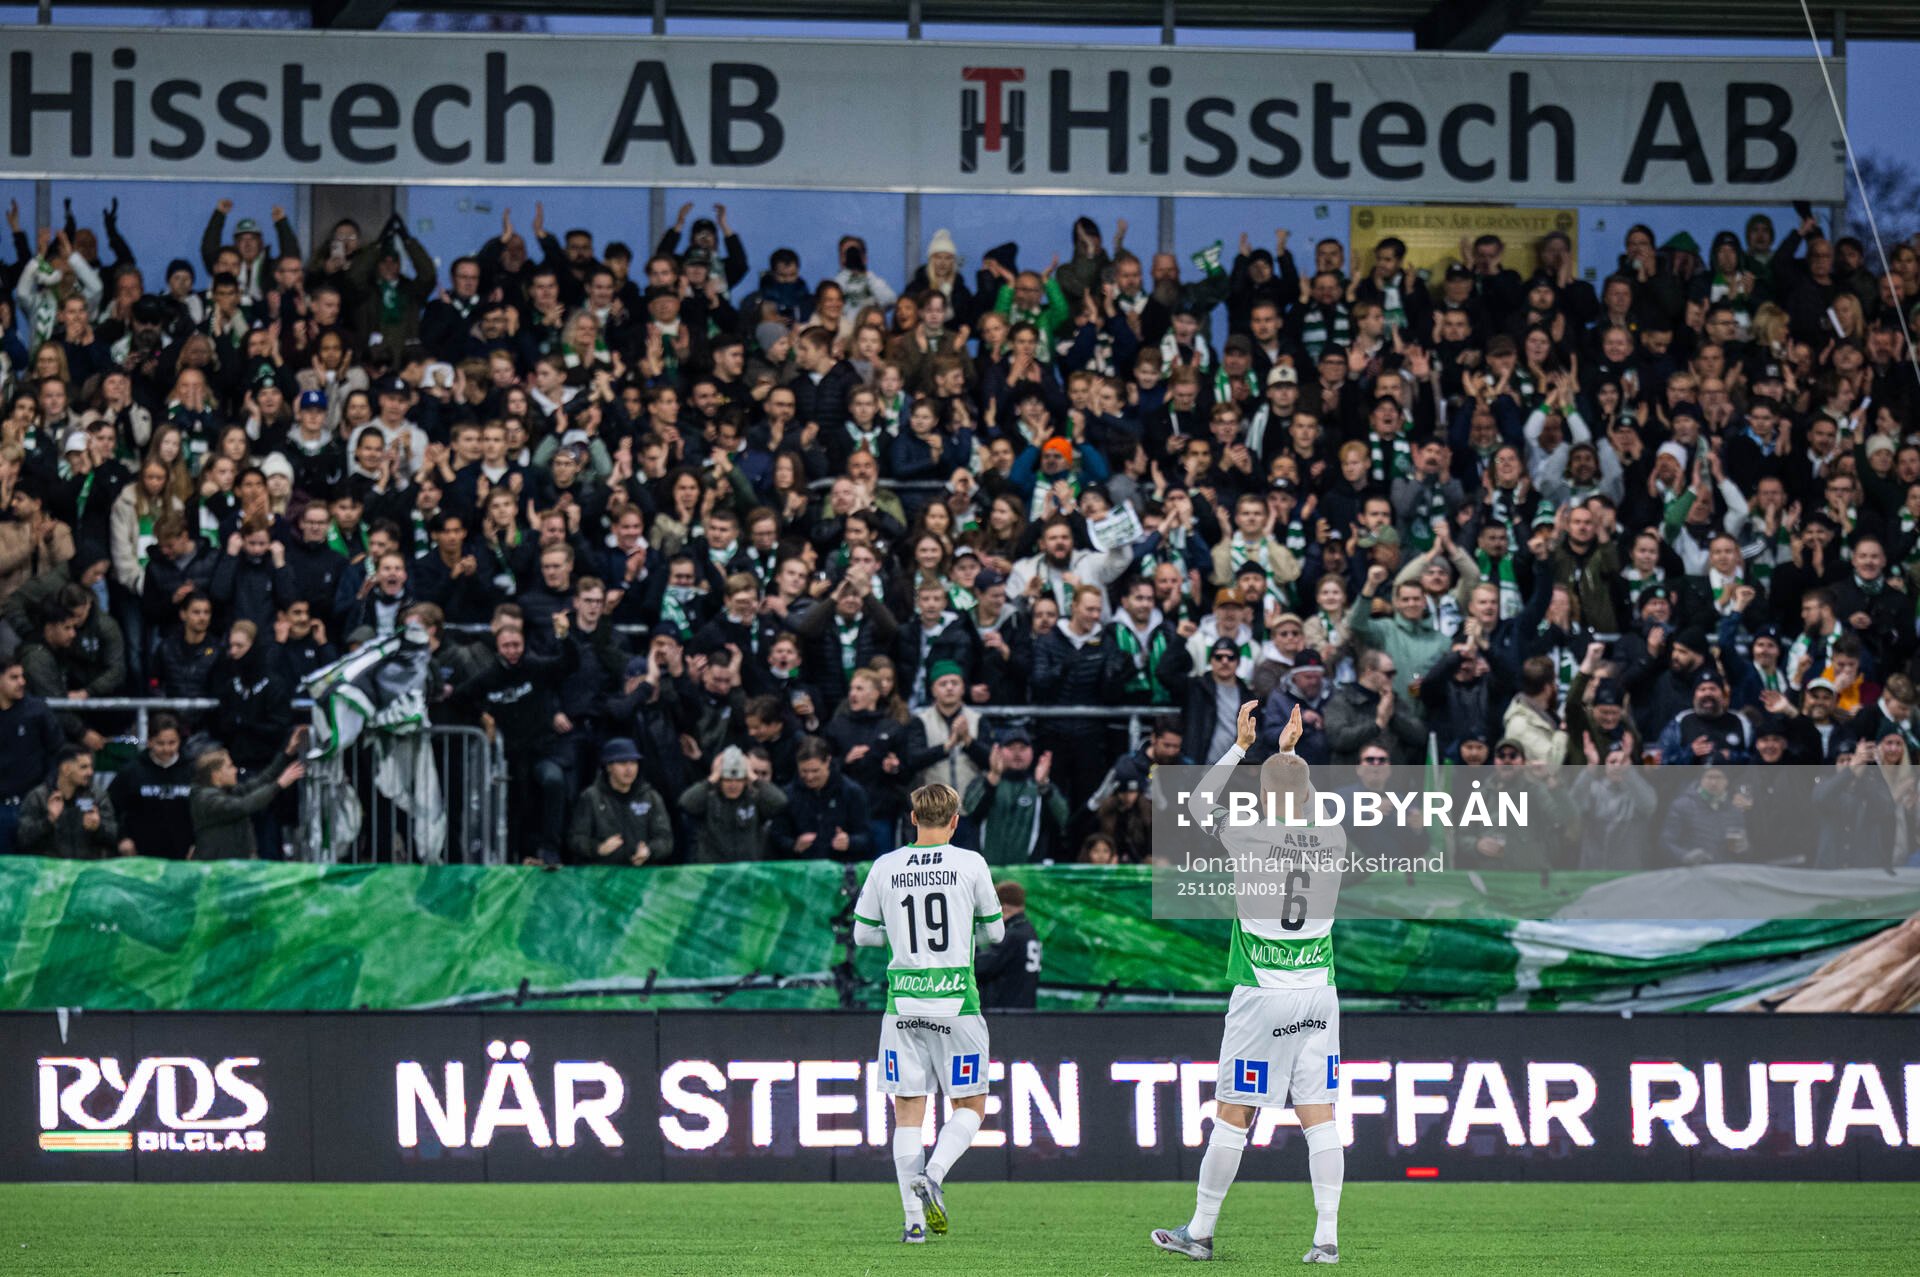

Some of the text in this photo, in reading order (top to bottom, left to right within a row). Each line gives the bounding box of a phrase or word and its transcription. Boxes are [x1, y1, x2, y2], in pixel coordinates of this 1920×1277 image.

[9, 48, 786, 167] Hisstech AB
[1048, 65, 1798, 186] Hisstech AB
[906, 852, 943, 866] ABB
[1284, 833, 1321, 848] ABB
[891, 870, 957, 889] MAGNUSSON
[1280, 869, 1311, 931] 6
[900, 892, 949, 954] 19
[37, 1057, 269, 1130] RYDS
[396, 1040, 625, 1148] NÄR
[1110, 1061, 1598, 1147] TRFFAR
